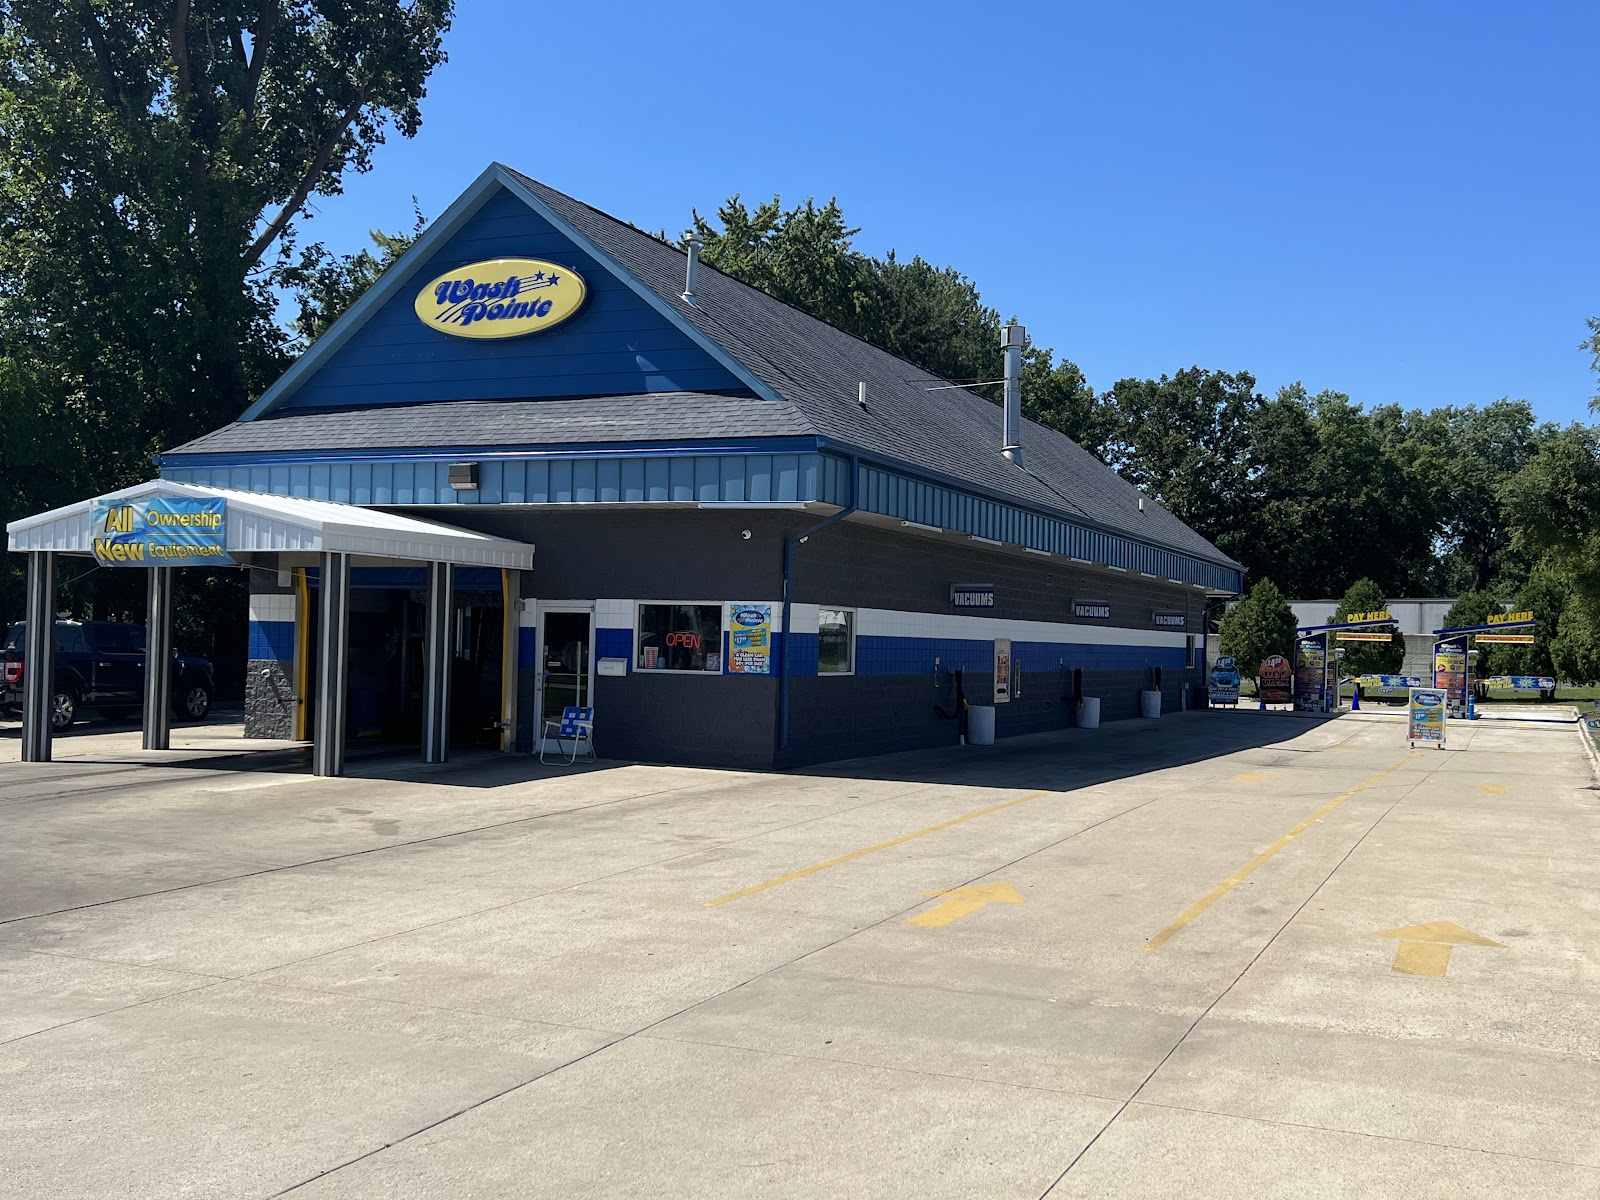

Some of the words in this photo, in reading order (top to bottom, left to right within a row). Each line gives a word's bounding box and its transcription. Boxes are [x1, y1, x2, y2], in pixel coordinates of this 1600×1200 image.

[434, 276, 521, 305] Wash
[459, 296, 553, 326] Pointe
[104, 506, 134, 532] All
[146, 509, 222, 530] Ownership
[94, 538, 145, 561] New
[148, 542, 224, 560] Equipment
[954, 592, 994, 606] VACUUMS
[1075, 605, 1110, 618] VACUUMS
[1347, 612, 1365, 623] PAY
[1367, 611, 1392, 621] HERE
[1487, 614, 1505, 625] PAY
[1508, 611, 1534, 623] HERE
[1155, 615, 1185, 626] VACUUMS
[665, 632, 702, 648] OPEN
[1261, 679, 1290, 687] WAX
